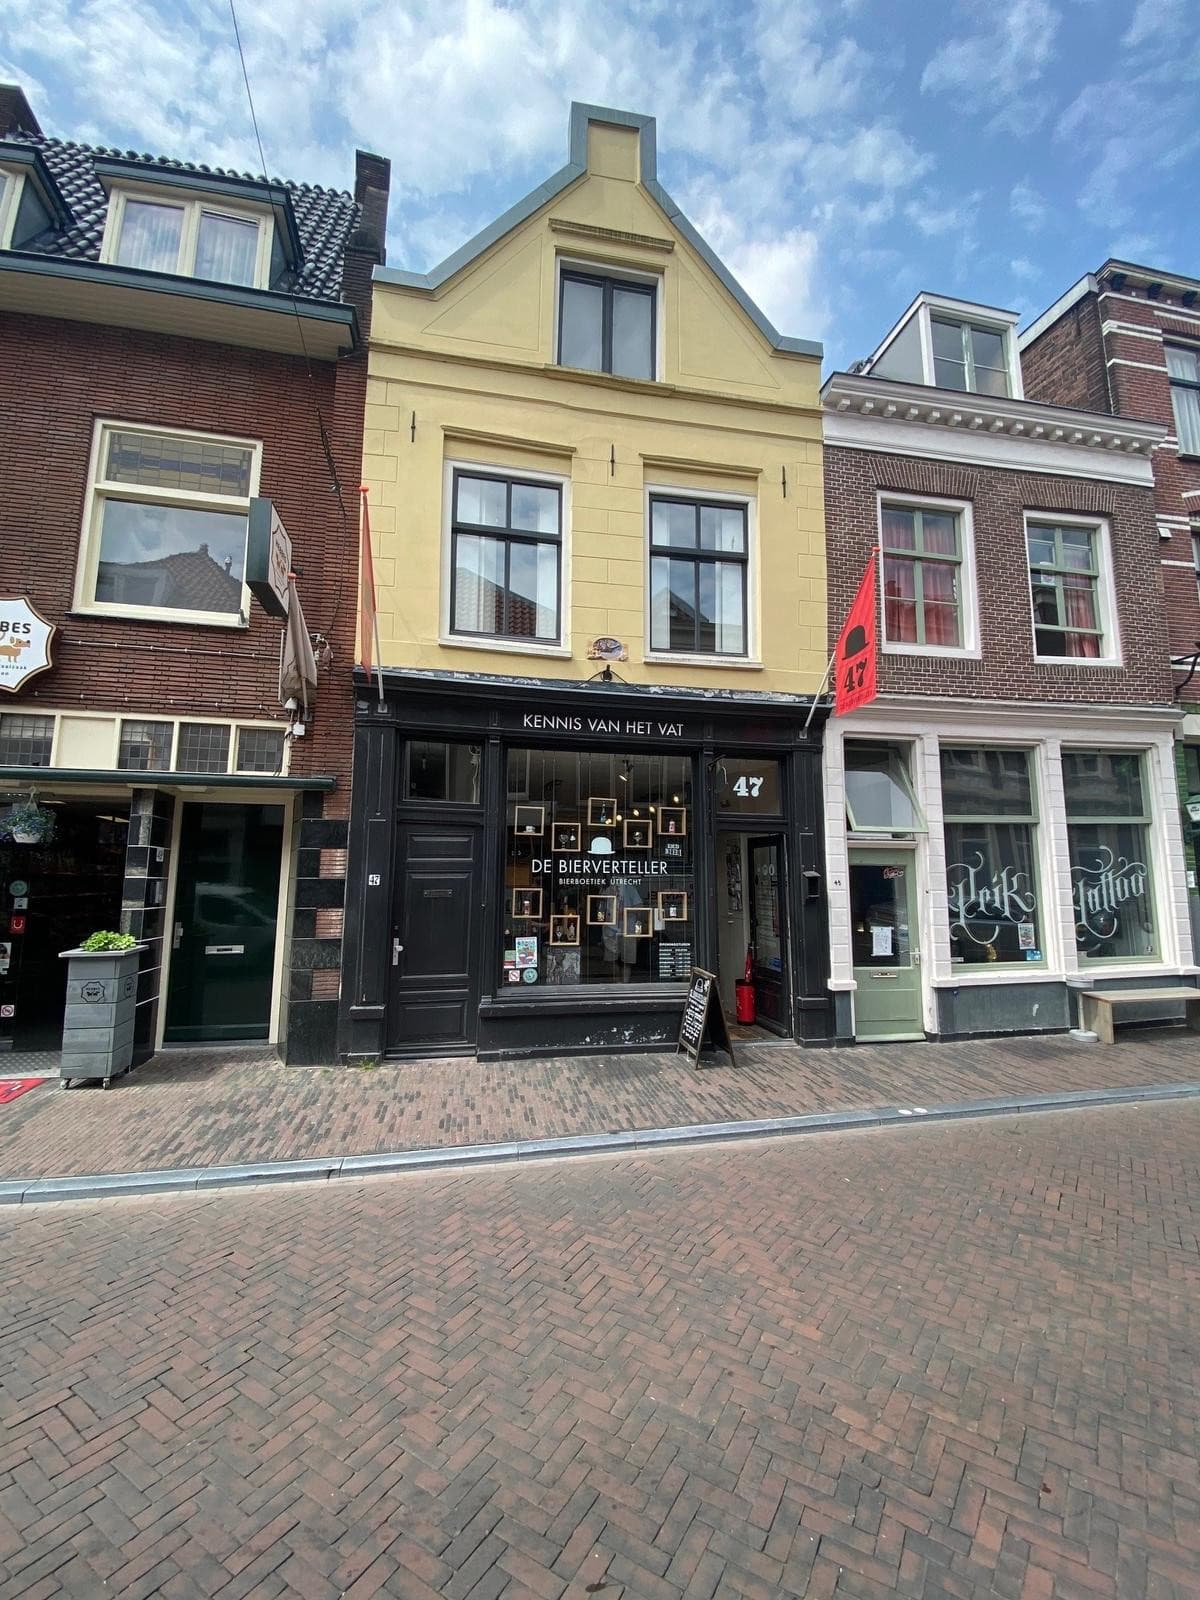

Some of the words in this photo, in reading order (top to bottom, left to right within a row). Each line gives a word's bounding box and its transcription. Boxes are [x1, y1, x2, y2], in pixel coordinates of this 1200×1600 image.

[844, 658, 868, 693] 47
[523, 713, 582, 730] KENNIS
[587, 718, 620, 733] VAN
[626, 720, 653, 735] HET
[657, 722, 684, 737] VAT
[733, 776, 764, 797] 47
[532, 859, 552, 873] DE
[559, 859, 668, 875] BIERVERTELLER
[610, 878, 642, 886] UTRECHT
[1071, 845, 1147, 941] Tattoo
